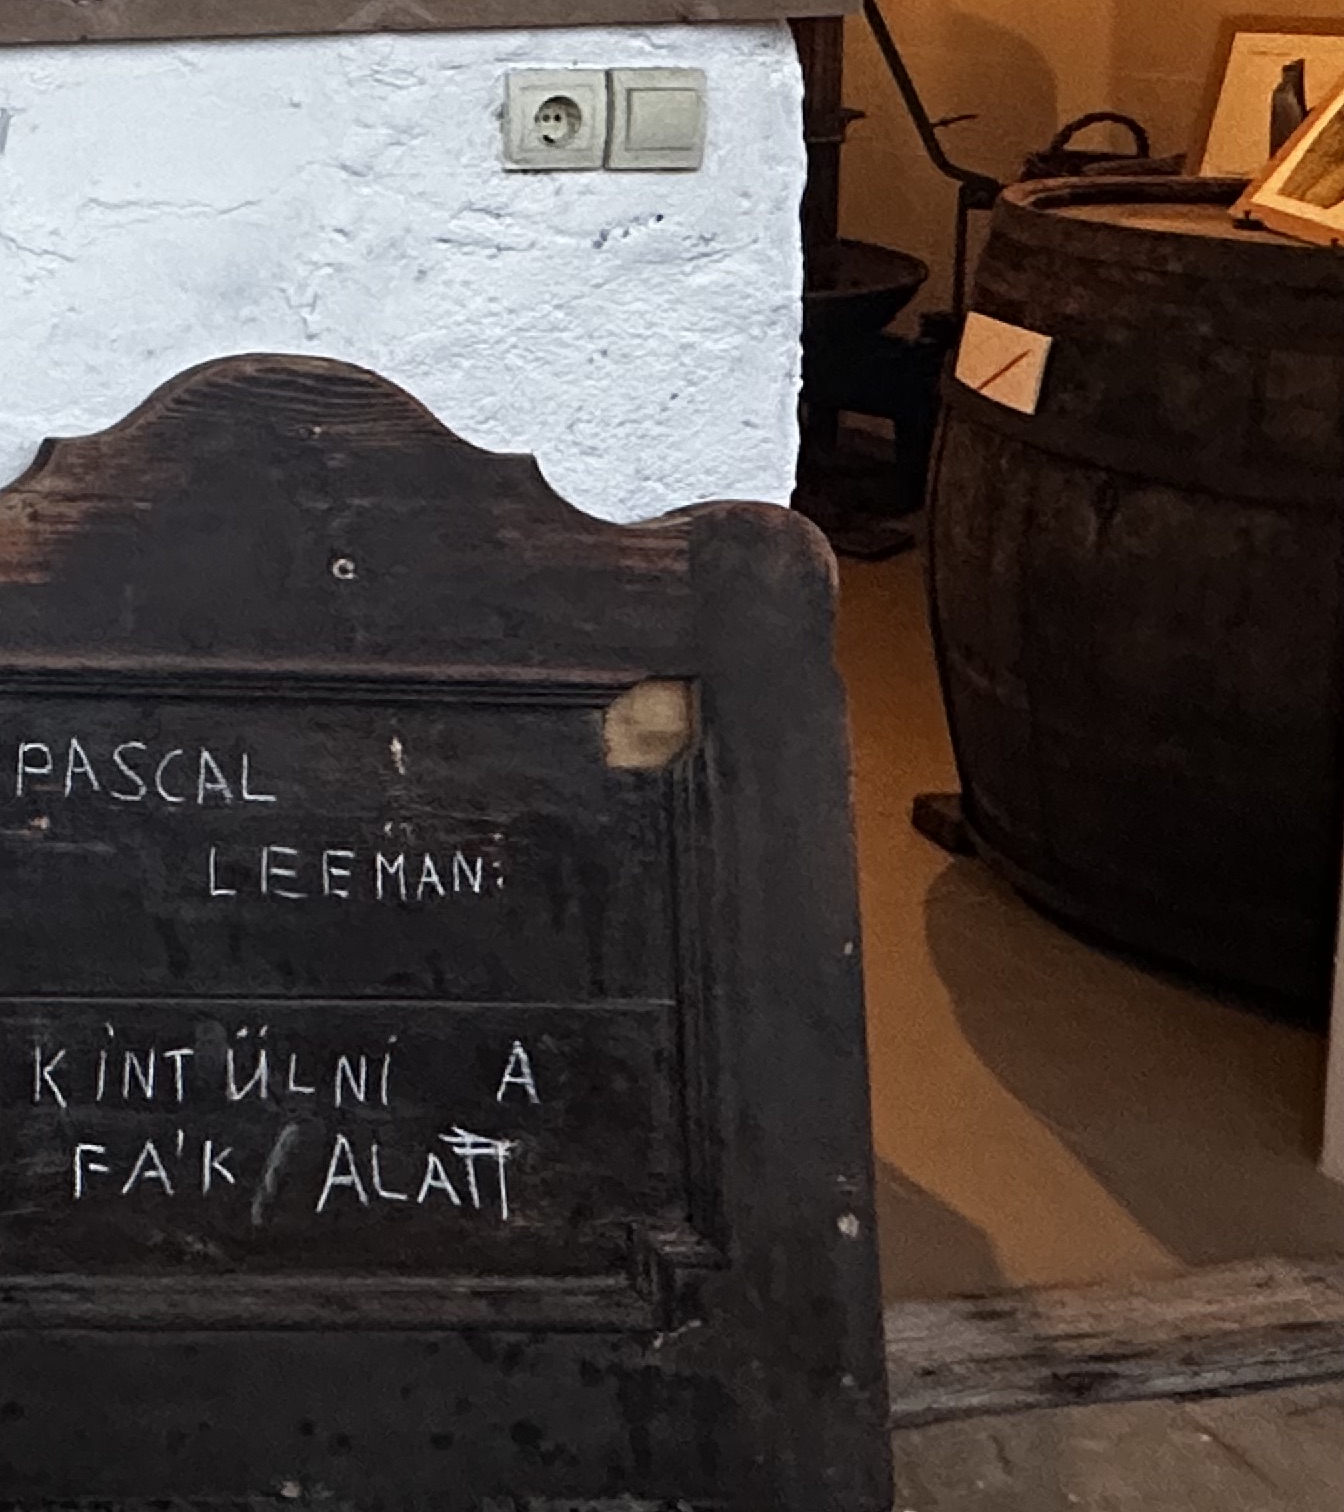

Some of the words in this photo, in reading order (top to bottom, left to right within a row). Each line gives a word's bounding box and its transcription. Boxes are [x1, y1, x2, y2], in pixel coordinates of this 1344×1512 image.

[15, 738, 277, 805] PASCAL
[496, 1040, 541, 1106] A
[315, 1125, 516, 1221] ALATT
